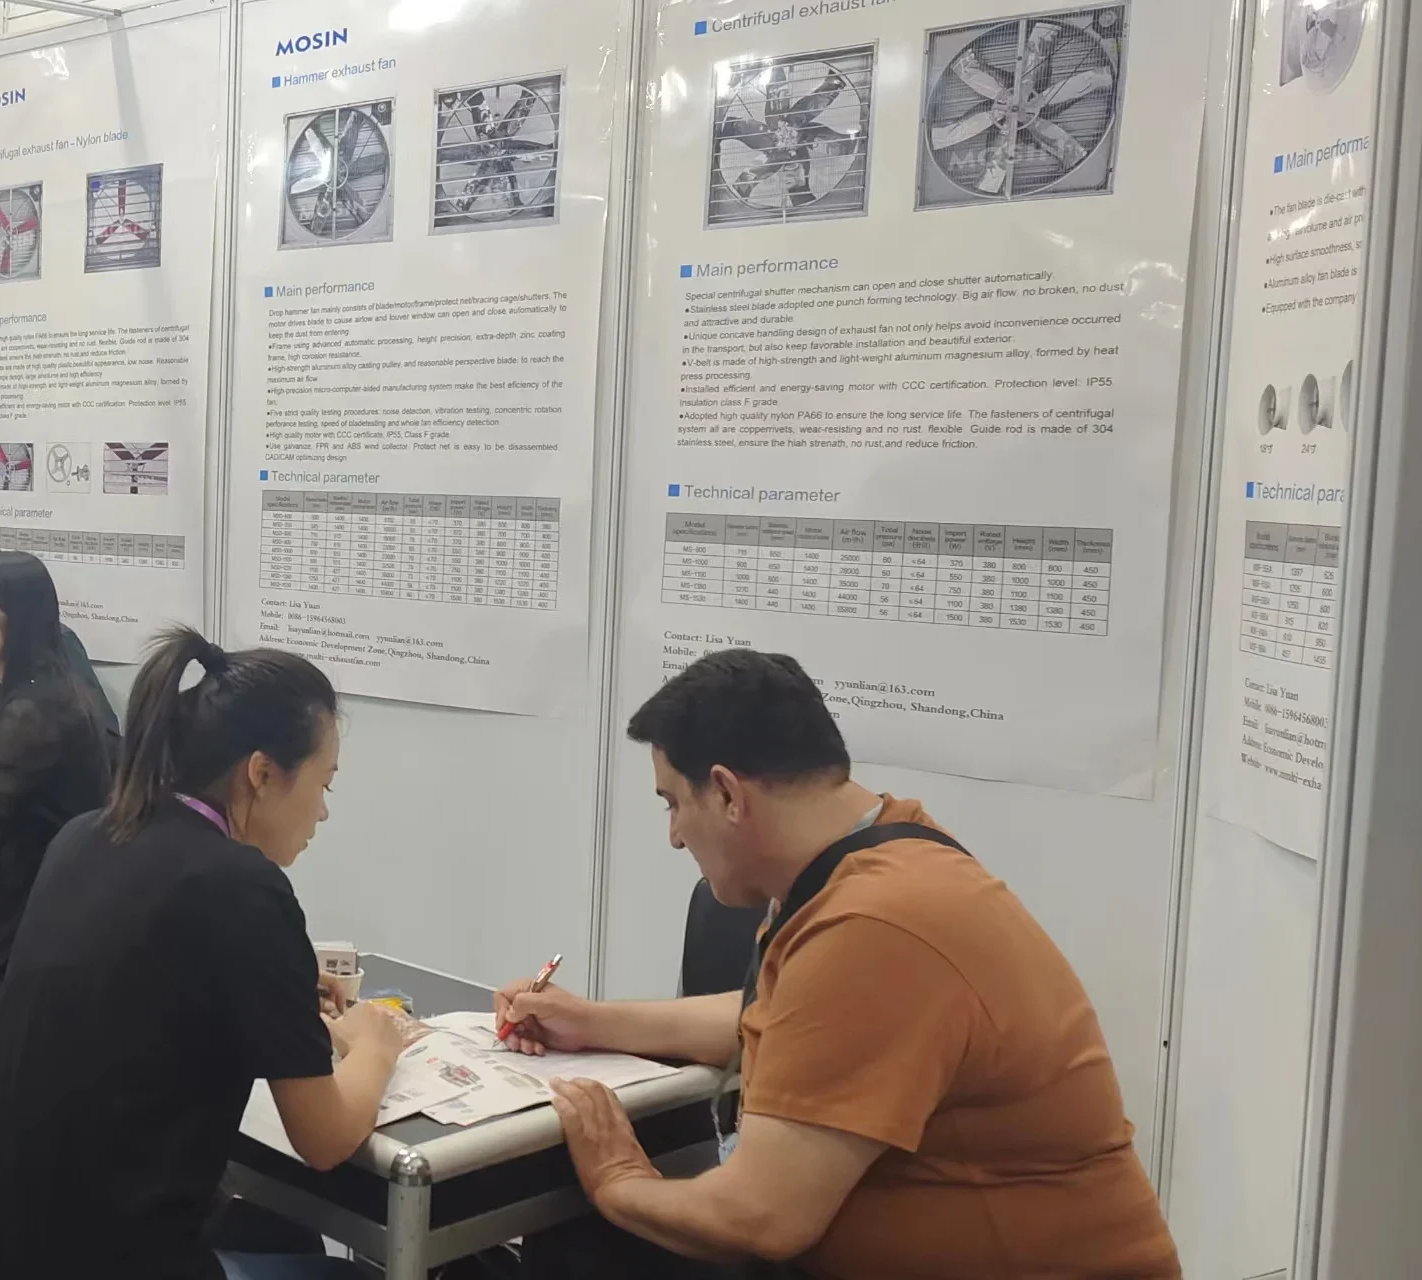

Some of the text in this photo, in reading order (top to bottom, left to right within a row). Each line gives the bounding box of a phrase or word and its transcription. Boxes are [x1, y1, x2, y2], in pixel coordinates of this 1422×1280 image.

[712, 0, 866, 33] Centrifugal exhaust
[276, 28, 348, 56] MOSIN
[284, 57, 396, 87] Hammer exhaust fan
[22, 138, 54, 156] exhaust
[55, 138, 69, 150] fan
[76, 134, 101, 149] Nylon
[103, 130, 128, 142] blade
[1286, 149, 1313, 171] Main
[1274, 205, 1285, 216] The
[696, 258, 839, 278] Main performance
[276, 281, 375, 299] Main performance
[686, 274, 981, 302] Special centrifugal shutter mechanism can open and close shutter
[730, 300, 749, 311] steel
[752, 299, 775, 310] blade
[778, 297, 814, 310] adopted
[817, 299, 833, 307] one
[836, 294, 864, 308] punch
[867, 293, 901, 305] forming
[963, 289, 978, 301] Big
[981, 288, 994, 298] air
[1100, 281, 1124, 292] dust
[0, 313, 46, 328] performance
[720, 331, 754, 339] concave
[757, 326, 794, 339] handling
[796, 325, 826, 338] design
[829, 324, 838, 335] of
[840, 323, 876, 334] exhaust
[879, 322, 893, 333] fan
[896, 321, 911, 332] not
[913, 321, 933, 333] only
[936, 320, 961, 332] helps
[965, 318, 990, 329] avoid
[994, 316, 1069, 328] inconvenience
[1072, 313, 1121, 325] occurred
[723, 382, 756, 392] efficient
[760, 381, 775, 392] and
[781, 380, 844, 394] energy-saving
[849, 380, 875, 390] motor
[879, 380, 897, 390] with
[902, 379, 926, 390] CCC
[995, 377, 1047, 388] Protection
[1086, 376, 1112, 387] IP55
[720, 410, 737, 422] high
[740, 410, 767, 422] quality
[771, 409, 794, 422] nylon
[797, 409, 822, 420] PA66
[825, 409, 833, 420] to
[870, 409, 884, 419] the
[887, 409, 906, 422] long
[910, 409, 944, 419] service
[968, 409, 987, 419] The
[991, 408, 1039, 419] fasteners
[1042, 408, 1053, 418] of
[1056, 408, 1114, 421] centrifugal
[971, 423, 1113, 433] Guide rod is made of 304
[272, 470, 380, 486] Technical parameter
[684, 484, 840, 504] Technical parameter
[1256, 482, 1315, 500] Technical
[14, 508, 53, 520] parameter
[289, 601, 301, 609] Lisa
[664, 630, 752, 646] Contact: Lisa Yuan
[662, 646, 697, 657] Mobile:
[834, 680, 935, 697] yyunlian@163.com
[910, 702, 1004, 721] Shandong,China
